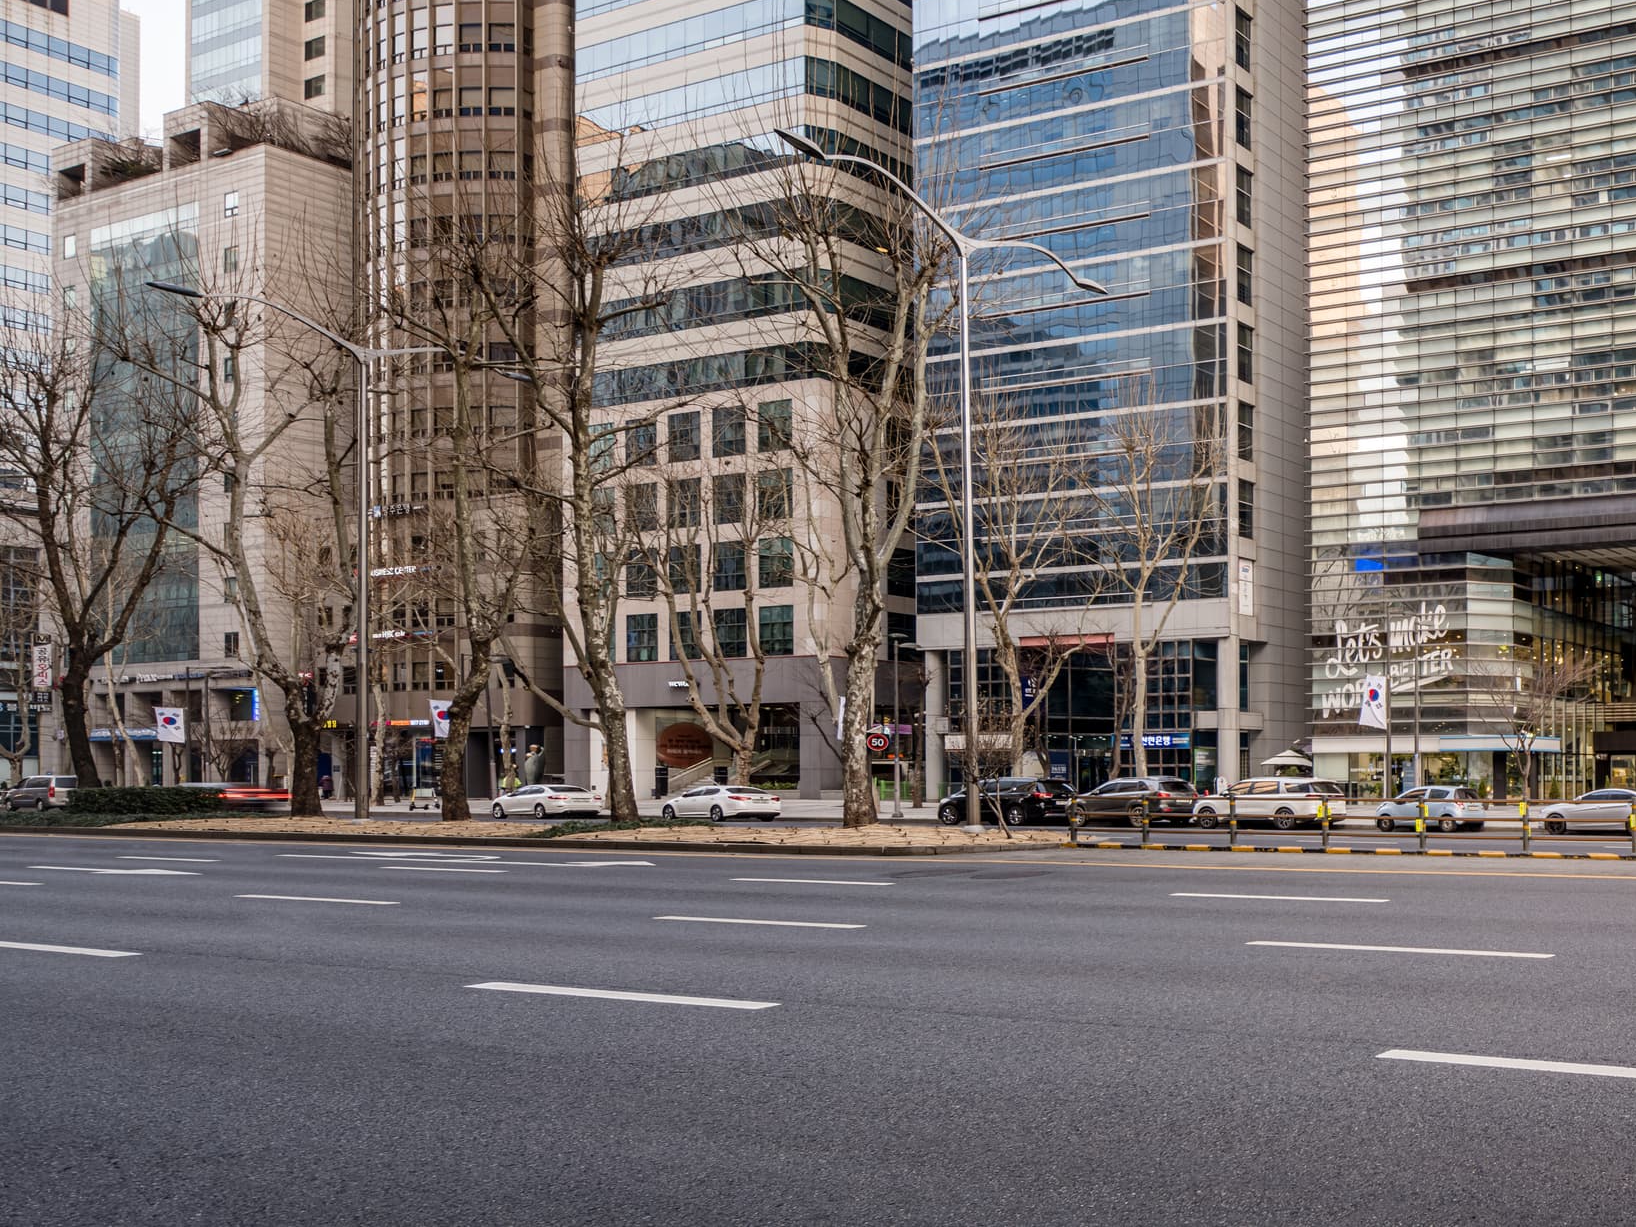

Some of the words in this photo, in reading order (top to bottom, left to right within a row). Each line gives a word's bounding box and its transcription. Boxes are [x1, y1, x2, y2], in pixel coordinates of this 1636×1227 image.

[1325, 619, 1382, 679] Let's
[1389, 601, 1450, 653] make
[37, 647, 49, 686] 공유오피스
[1389, 648, 1454, 688] BETTER
[871, 738, 885, 747] 50
